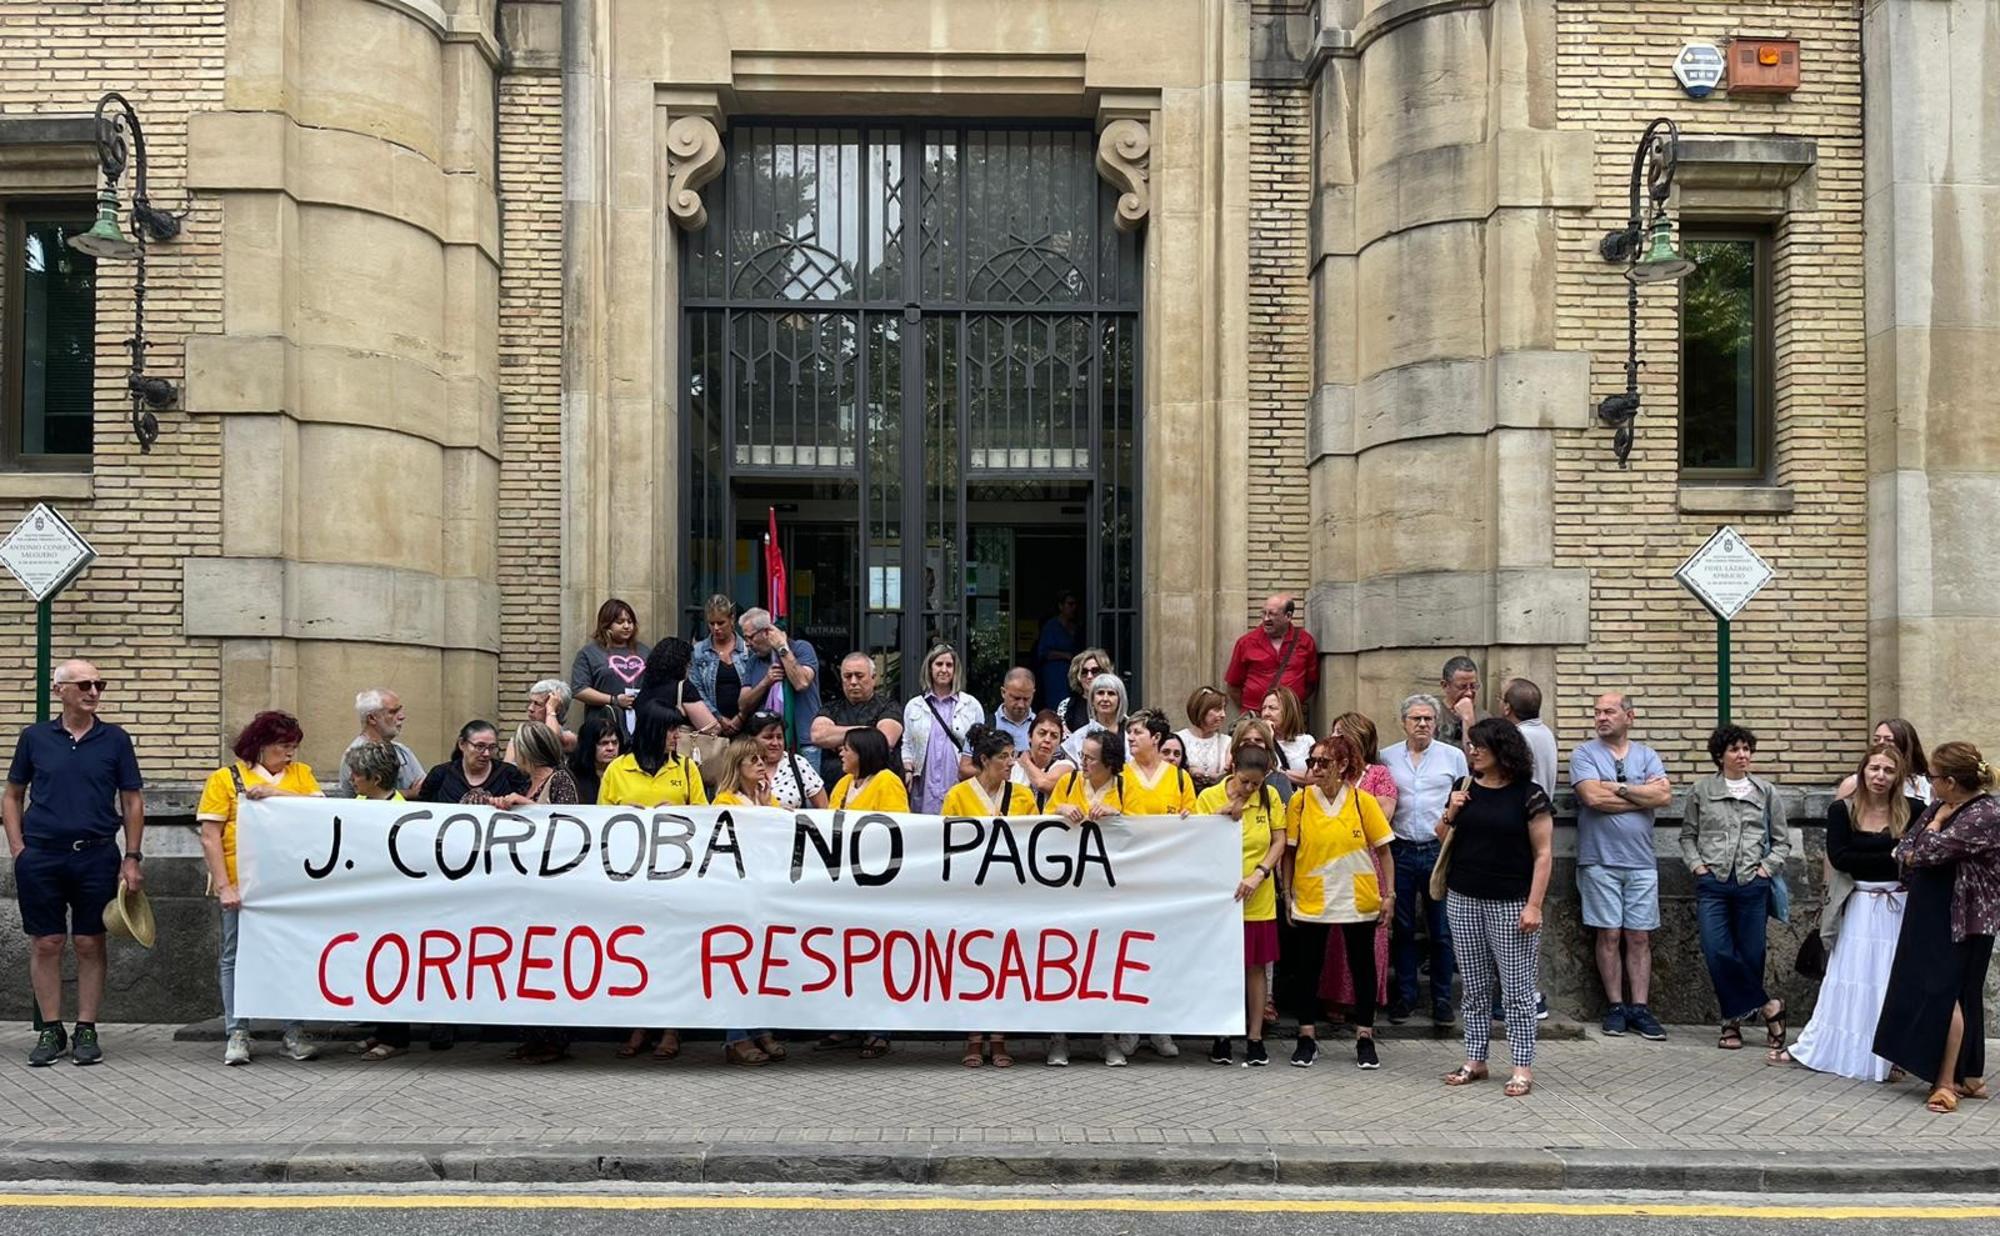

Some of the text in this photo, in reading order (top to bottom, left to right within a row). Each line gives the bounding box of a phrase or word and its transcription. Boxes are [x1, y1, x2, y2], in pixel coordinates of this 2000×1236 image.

[304, 809, 1117, 888] J. CORDOBA NO PAGA
[317, 924, 1156, 1006] CORREOS RESPONSABLE
